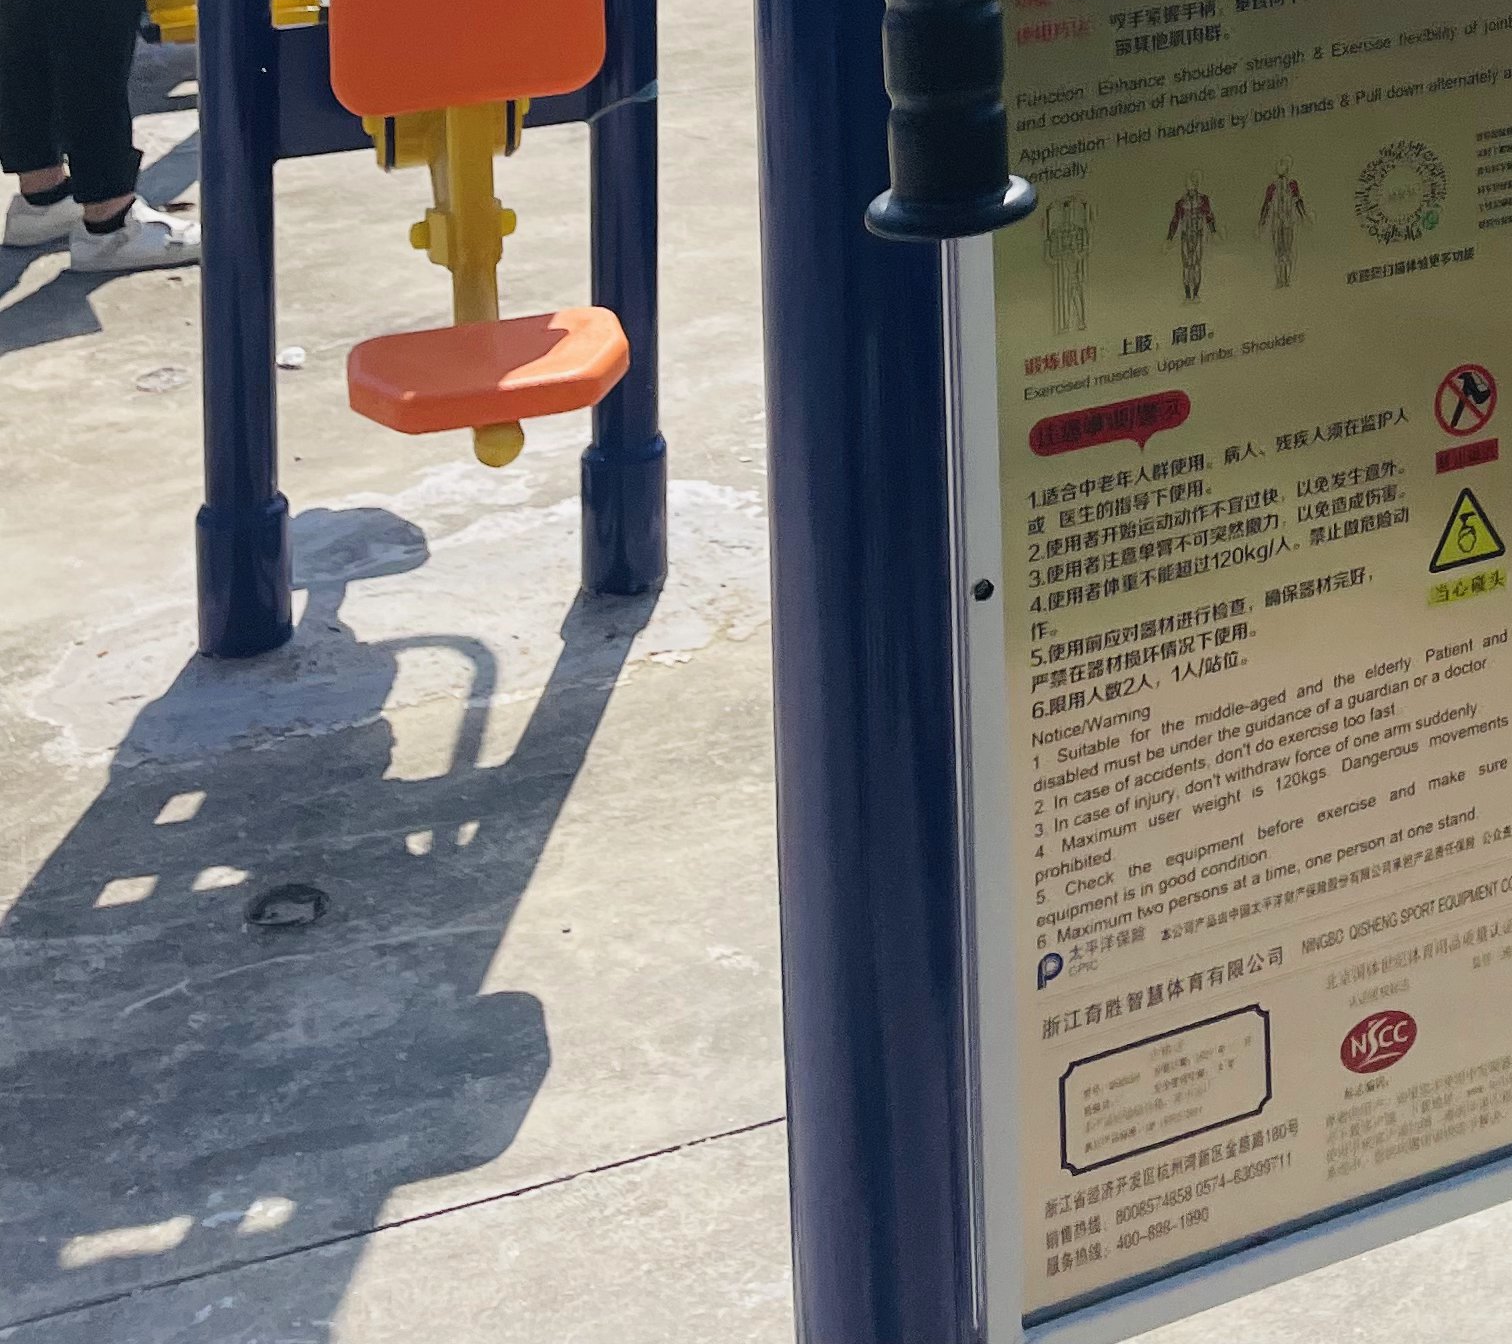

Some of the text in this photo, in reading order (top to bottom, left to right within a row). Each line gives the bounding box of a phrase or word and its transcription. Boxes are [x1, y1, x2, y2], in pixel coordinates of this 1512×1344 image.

[1173, 62, 1239, 83] shoulder
[1246, 48, 1305, 73] strength
[1464, 20, 1479, 36] of
[1016, 115, 1046, 132] and
[1152, 93, 1166, 110] of
[1220, 82, 1248, 99] and
[1116, 128, 1151, 146] Hold
[1231, 113, 1247, 130] by
[1254, 105, 1285, 124] both
[1291, 97, 1335, 117] hands
[1355, 87, 1383, 106] Pull
[1387, 82, 1425, 100] down
[1033, 761, 1100, 793] disabled
[1104, 753, 1142, 773] must
[1146, 746, 1165, 762] be
[1170, 733, 1213, 755] under
[1218, 725, 1241, 742] the
[1246, 706, 1312, 738] guidance
[1316, 697, 1331, 714] of
[1334, 697, 1343, 710] a
[1348, 679, 1410, 709] guardian
[1413, 675, 1427, 689] or
[1431, 671, 1440, 684] a
[1057, 736, 1120, 764] Suitable
[1130, 728, 1152, 743] for
[1161, 719, 1185, 736] the
[1195, 689, 1287, 726] middle-aged
[1296, 680, 1324, 699] and
[1333, 672, 1355, 689] the
[1425, 639, 1473, 663] Patient
[1482, 629, 1508, 648] and
[1054, 793, 1069, 811] In
[1073, 785, 1111, 805] case
[1115, 775, 1130, 792] of
[1215, 742, 1252, 765] don't
[1255, 736, 1274, 754] do
[1278, 720, 1339, 748] exercise
[1343, 712, 1366, 730] too
[1054, 816, 1069, 833] In
[1073, 807, 1111, 827] case
[1115, 798, 1130, 815] of
[1185, 772, 1221, 796] don't
[1225, 756, 1291, 784] withdraw
[1295, 743, 1331, 765] force
[1335, 735, 1350, 753] of
[1353, 730, 1380, 748] one
[1384, 722, 1412, 740] arm
[1061, 820, 1138, 853] Maximum
[1148, 808, 1181, 827] user
[1192, 790, 1242, 815] weight
[1251, 784, 1265, 799] is
[1341, 739, 1420, 773] Dangerous
[1428, 716, 1510, 748] movements
[1065, 871, 1116, 897] Check
[1128, 860, 1153, 879] the
[1165, 832, 1245, 868] equipment
[1257, 816, 1305, 840] before
[1317, 795, 1378, 823] exercise
[1389, 782, 1417, 802] and
[1428, 769, 1466, 791] make
[1478, 758, 1508, 776] sure
[1035, 892, 1120, 928] equipment
[1123, 886, 1136, 903] is
[1140, 882, 1154, 898] in
[1159, 867, 1197, 895] good
[1056, 911, 1133, 945] Maximum
[1137, 902, 1164, 921] two
[1168, 883, 1229, 915] persons
[1233, 874, 1247, 891] at
[1251, 873, 1261, 886] a
[1305, 851, 1333, 870] one
[1336, 837, 1386, 864] person
[1389, 829, 1404, 844] at
[1407, 820, 1435, 839] one
[1041, 945, 1284, 1040] 浙江奇胜智慧体育有限公司
[1351, 1016, 1410, 1060] NSCC
